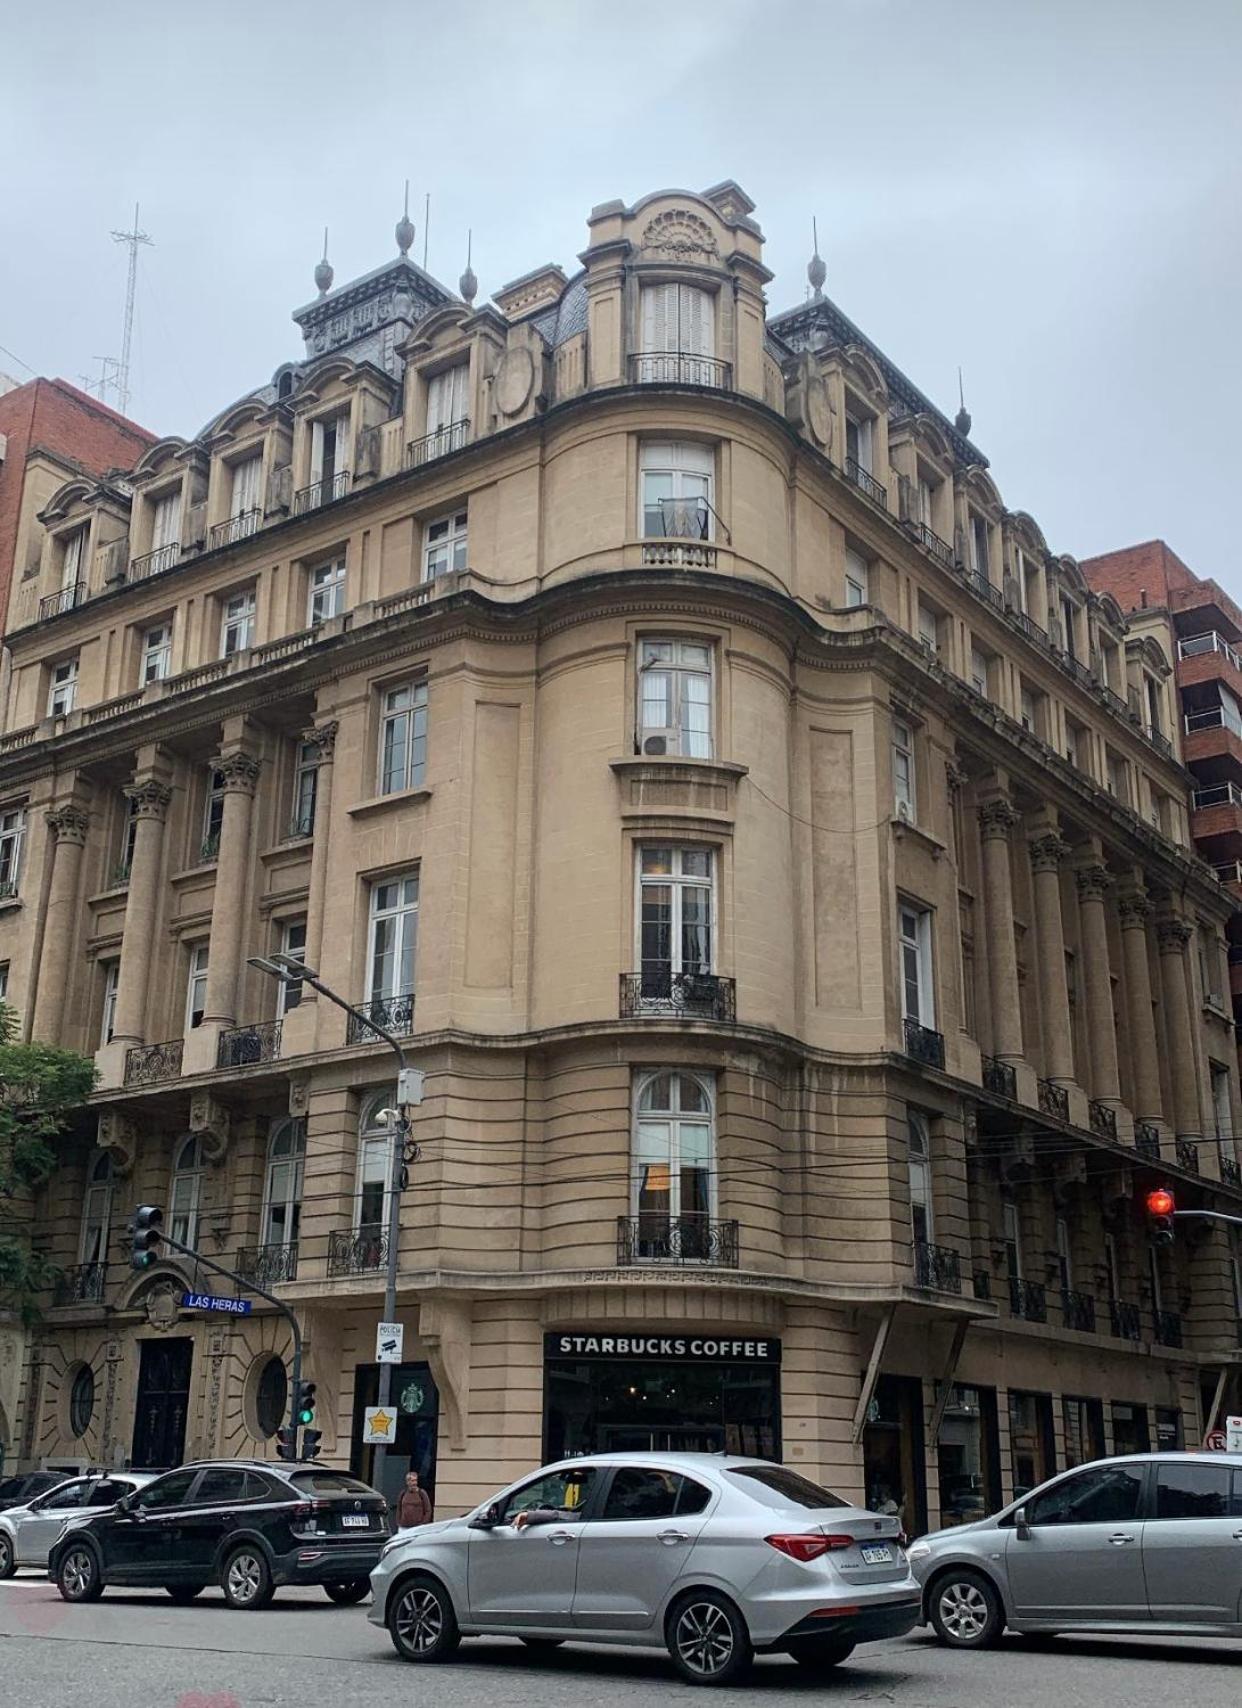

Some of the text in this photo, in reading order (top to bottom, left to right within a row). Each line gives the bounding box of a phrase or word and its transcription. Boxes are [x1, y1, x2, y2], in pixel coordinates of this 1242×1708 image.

[188, 1296, 245, 1313] LAS HERAS
[560, 1336, 768, 1357] STARBUCKS COFFEE
